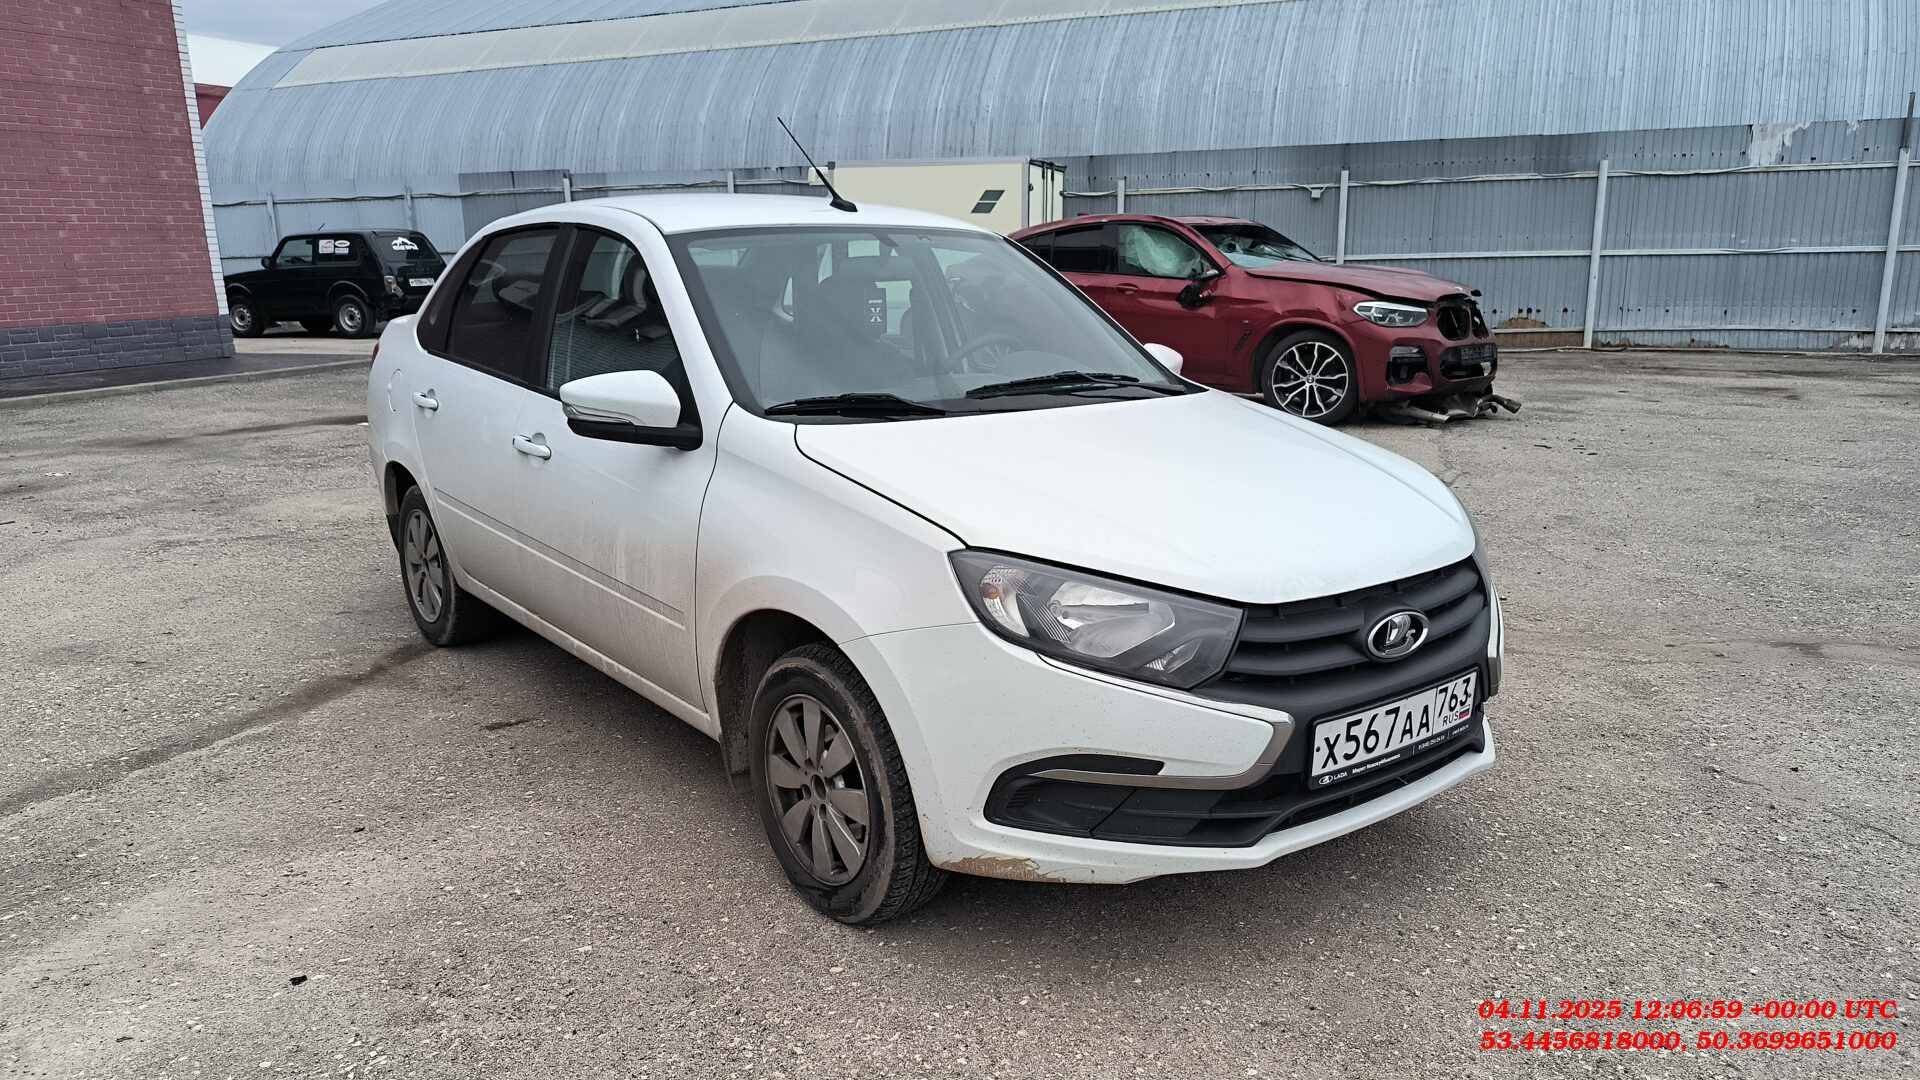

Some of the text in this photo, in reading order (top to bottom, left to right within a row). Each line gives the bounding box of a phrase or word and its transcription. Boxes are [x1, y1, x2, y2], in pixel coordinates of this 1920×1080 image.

[1321, 704, 1430, 769] Х567АА
[1438, 676, 1471, 718] 763
[1442, 710, 1459, 727] RUS
